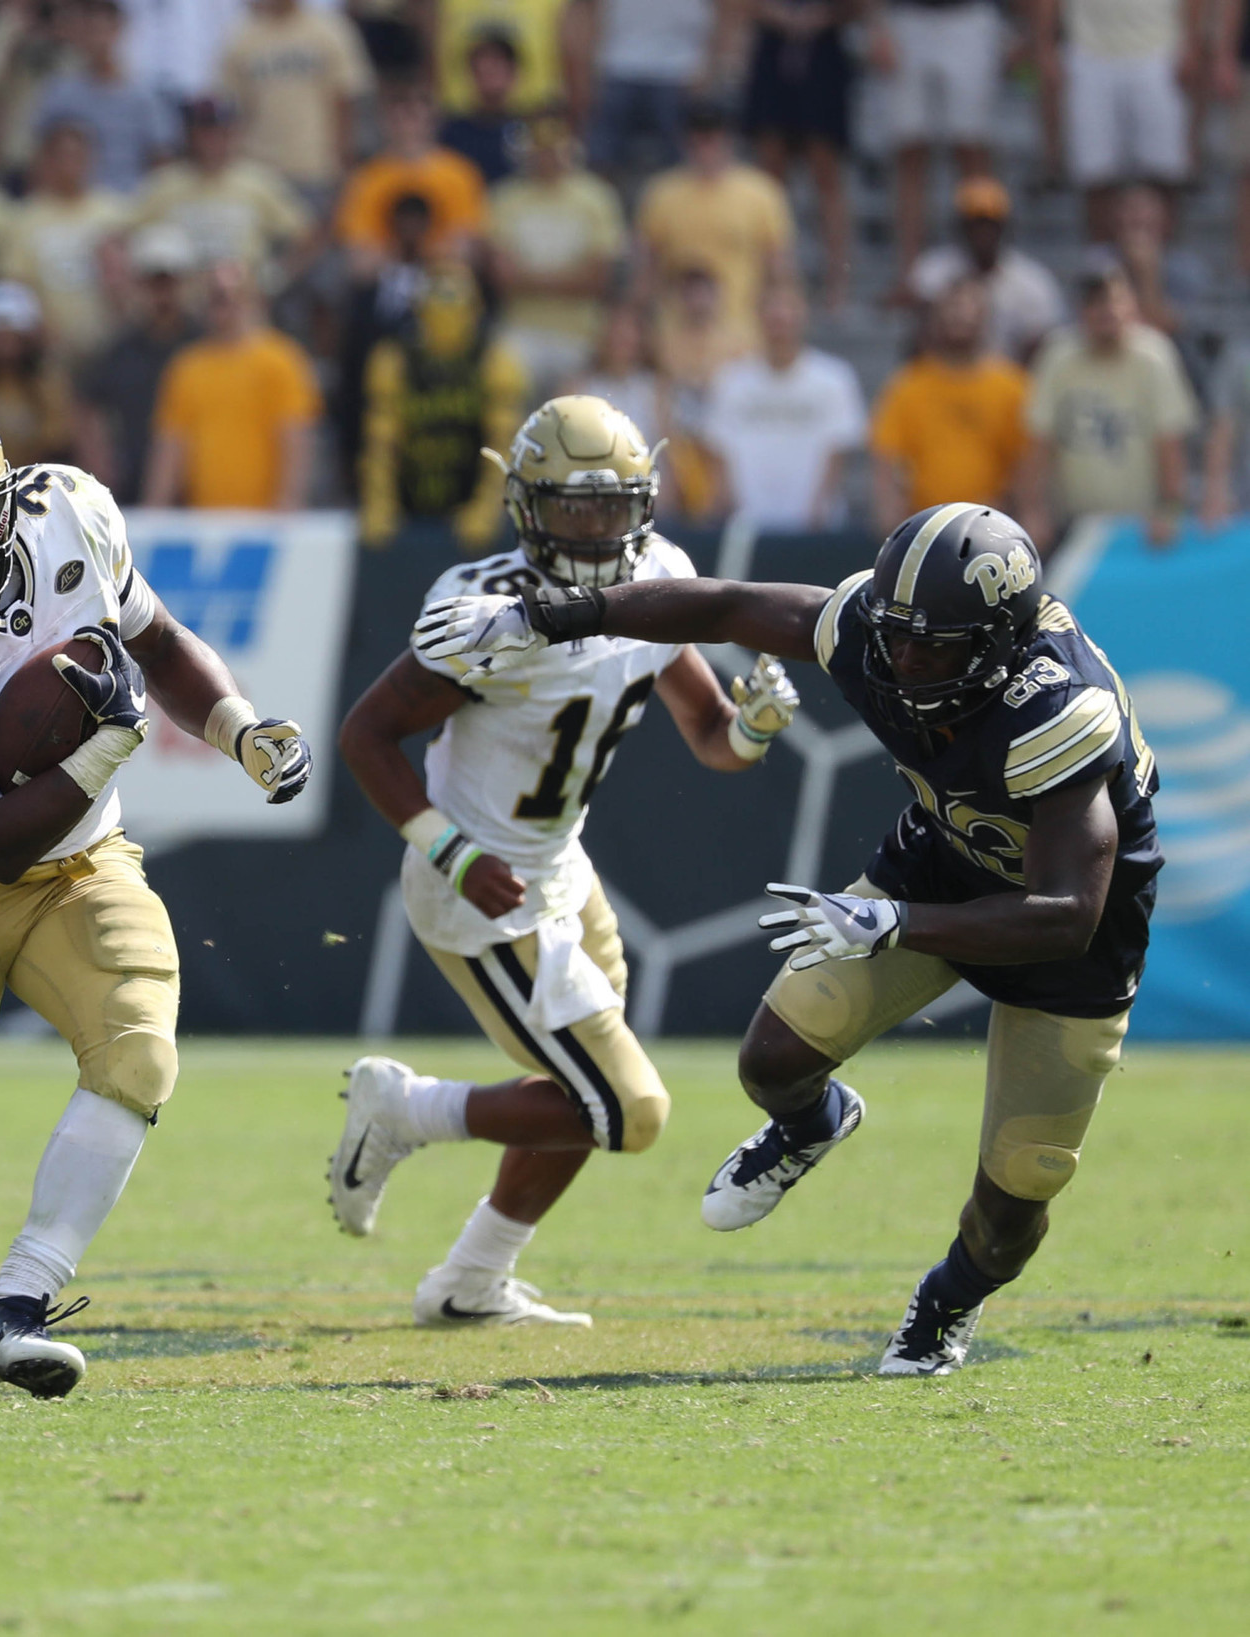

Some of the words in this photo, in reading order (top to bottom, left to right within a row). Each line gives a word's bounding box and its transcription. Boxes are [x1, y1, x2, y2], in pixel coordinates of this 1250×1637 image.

[59, 561, 83, 592] ACC
[963, 545, 1037, 607] Pitt
[13, 615, 30, 631] GT
[887, 604, 914, 618] ACC
[1002, 655, 1071, 709] 23
